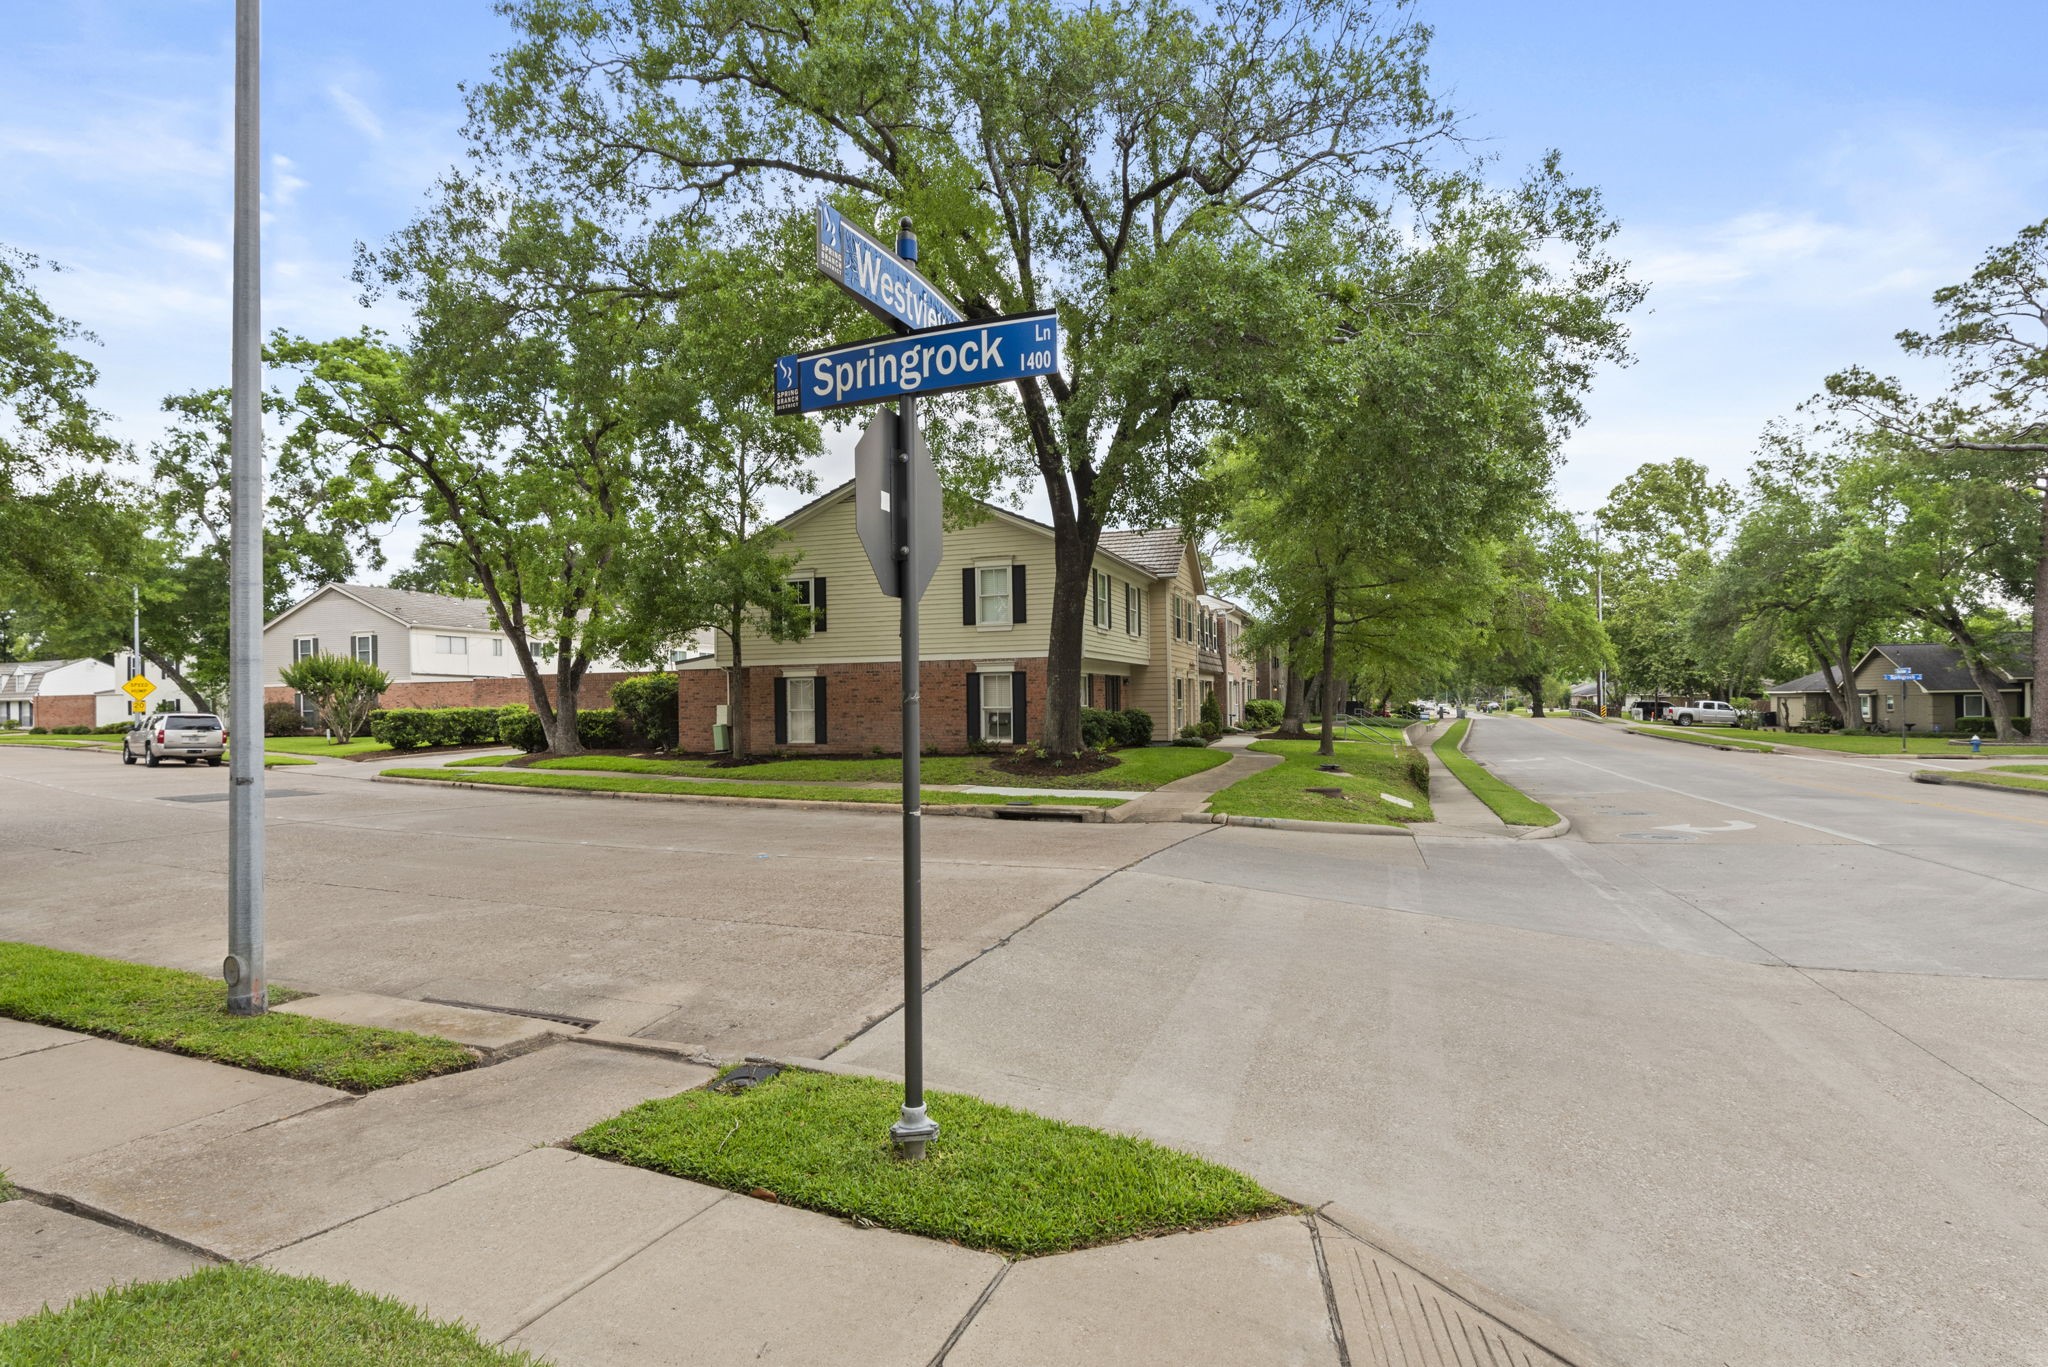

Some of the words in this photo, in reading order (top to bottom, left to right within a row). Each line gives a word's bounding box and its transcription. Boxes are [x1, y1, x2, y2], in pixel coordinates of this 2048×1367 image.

[821, 243, 842, 261] SPRING
[821, 251, 842, 269] BRANCH
[821, 259, 842, 275] DISTRICT
[1035, 324, 1051, 342] Ln
[813, 330, 1004, 401] Springrock
[1020, 350, 1051, 371] 1400
[777, 388, 798, 398] SPRING
[777, 395, 798, 405] BRANCH
[777, 402, 798, 410] DISTRICT
